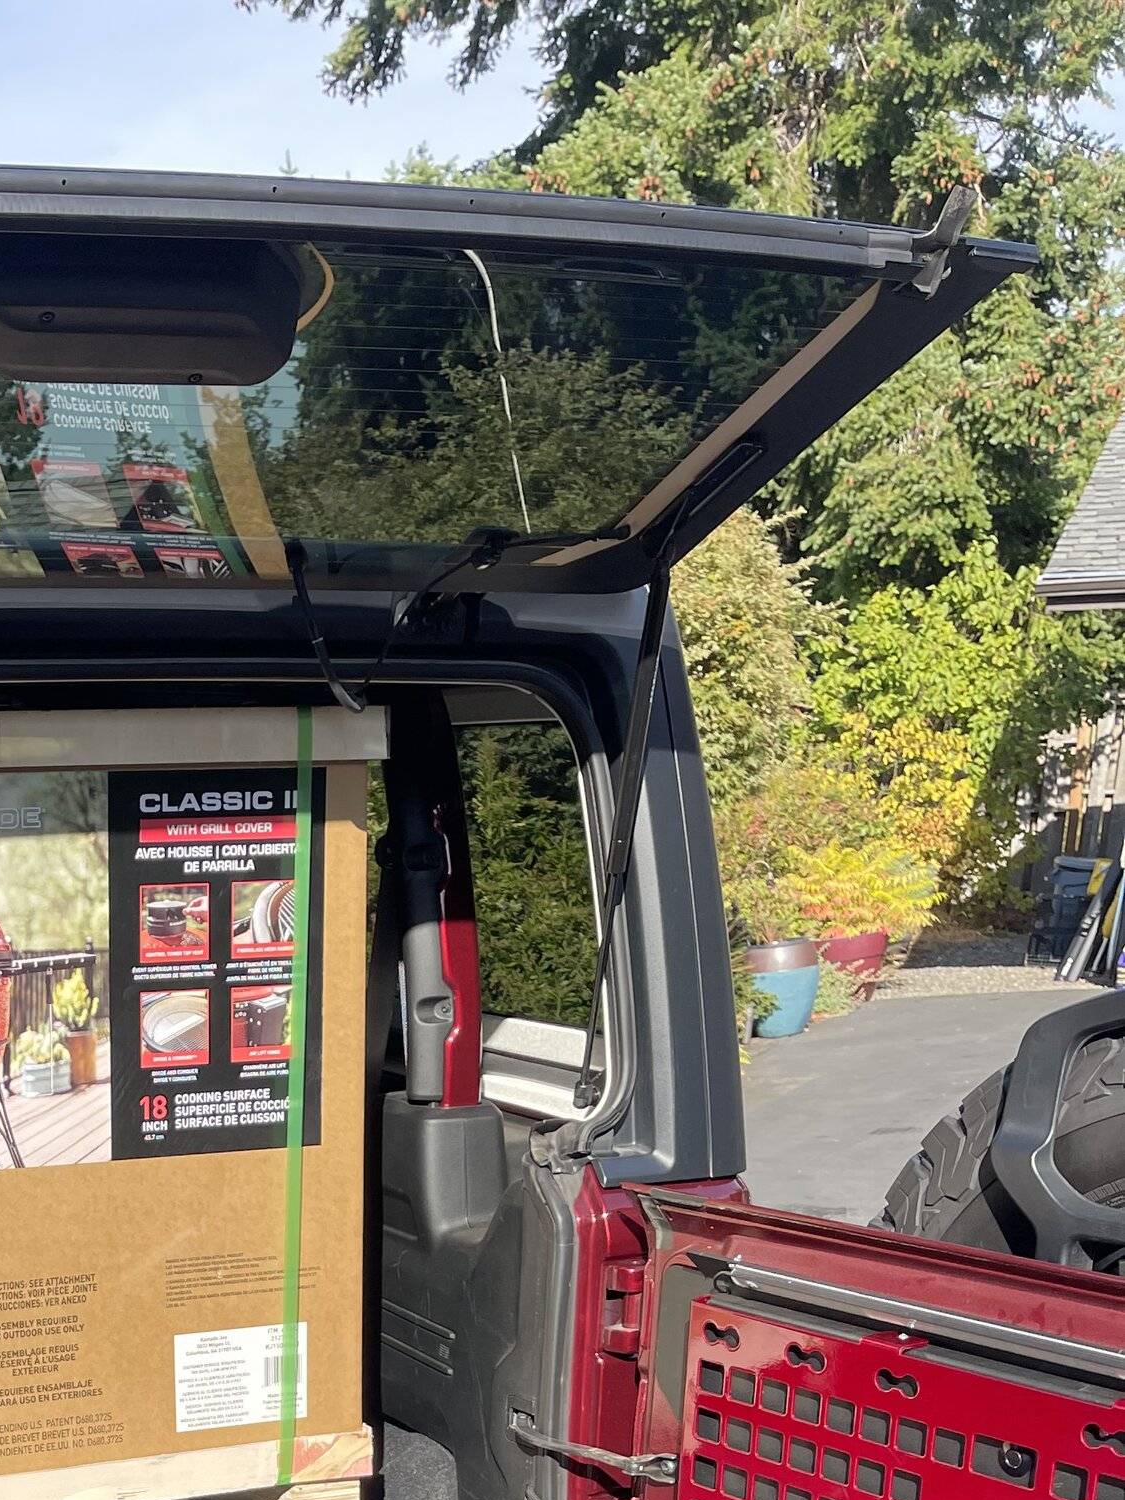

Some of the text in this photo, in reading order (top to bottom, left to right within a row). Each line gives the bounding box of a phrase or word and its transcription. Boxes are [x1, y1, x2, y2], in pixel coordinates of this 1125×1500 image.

[139, 791, 273, 813] CLASSIC
[166, 822, 272, 836] WITH GRILL COVER
[135, 847, 165, 860] AVEC
[168, 845, 213, 858] HOUSSE
[221, 845, 247, 857] CON
[183, 859, 255, 873] DE PARRILLA
[175, 1088, 270, 1104] COOKING SURFACE
[139, 1095, 168, 1120] 18
[175, 1102, 236, 1117] SUPERFICIE
[237, 1102, 252, 1112] DE
[142, 1120, 168, 1132] INCH
[175, 1111, 285, 1129] SURFACE DE CUISSON
[29, 1279, 44, 1288] SEE
[45, 1273, 96, 1287] ATTACHMENT
[27, 1288, 45, 1298] VOIR
[71, 1283, 98, 1294] JOINTE
[44, 1298, 60, 1307] VER
[61, 1294, 87, 1305] ANEXO
[36, 1315, 79, 1326] REQUIRED
[2, 1328, 44, 1340] OUTDOOR
[44, 1326, 61, 1335] USE
[62, 1323, 85, 1333] ONLY
[48, 1344, 80, 1354] REQUIS
[42, 1353, 76, 1364] L'USAGE
[36, 1379, 93, 1393] ENSAMBLAJE
[19, 1395, 36, 1405] USO
[38, 1394, 50, 1403] EN
[51, 1388, 103, 1401] EXTERIORES
[46, 1416, 74, 1428] PATENT
[0, 1435, 11, 1445] DE
[11, 1431, 40, 1444] BREVET
[41, 1428, 70, 1440] BREVET
[34, 1443, 45, 1453] DE
